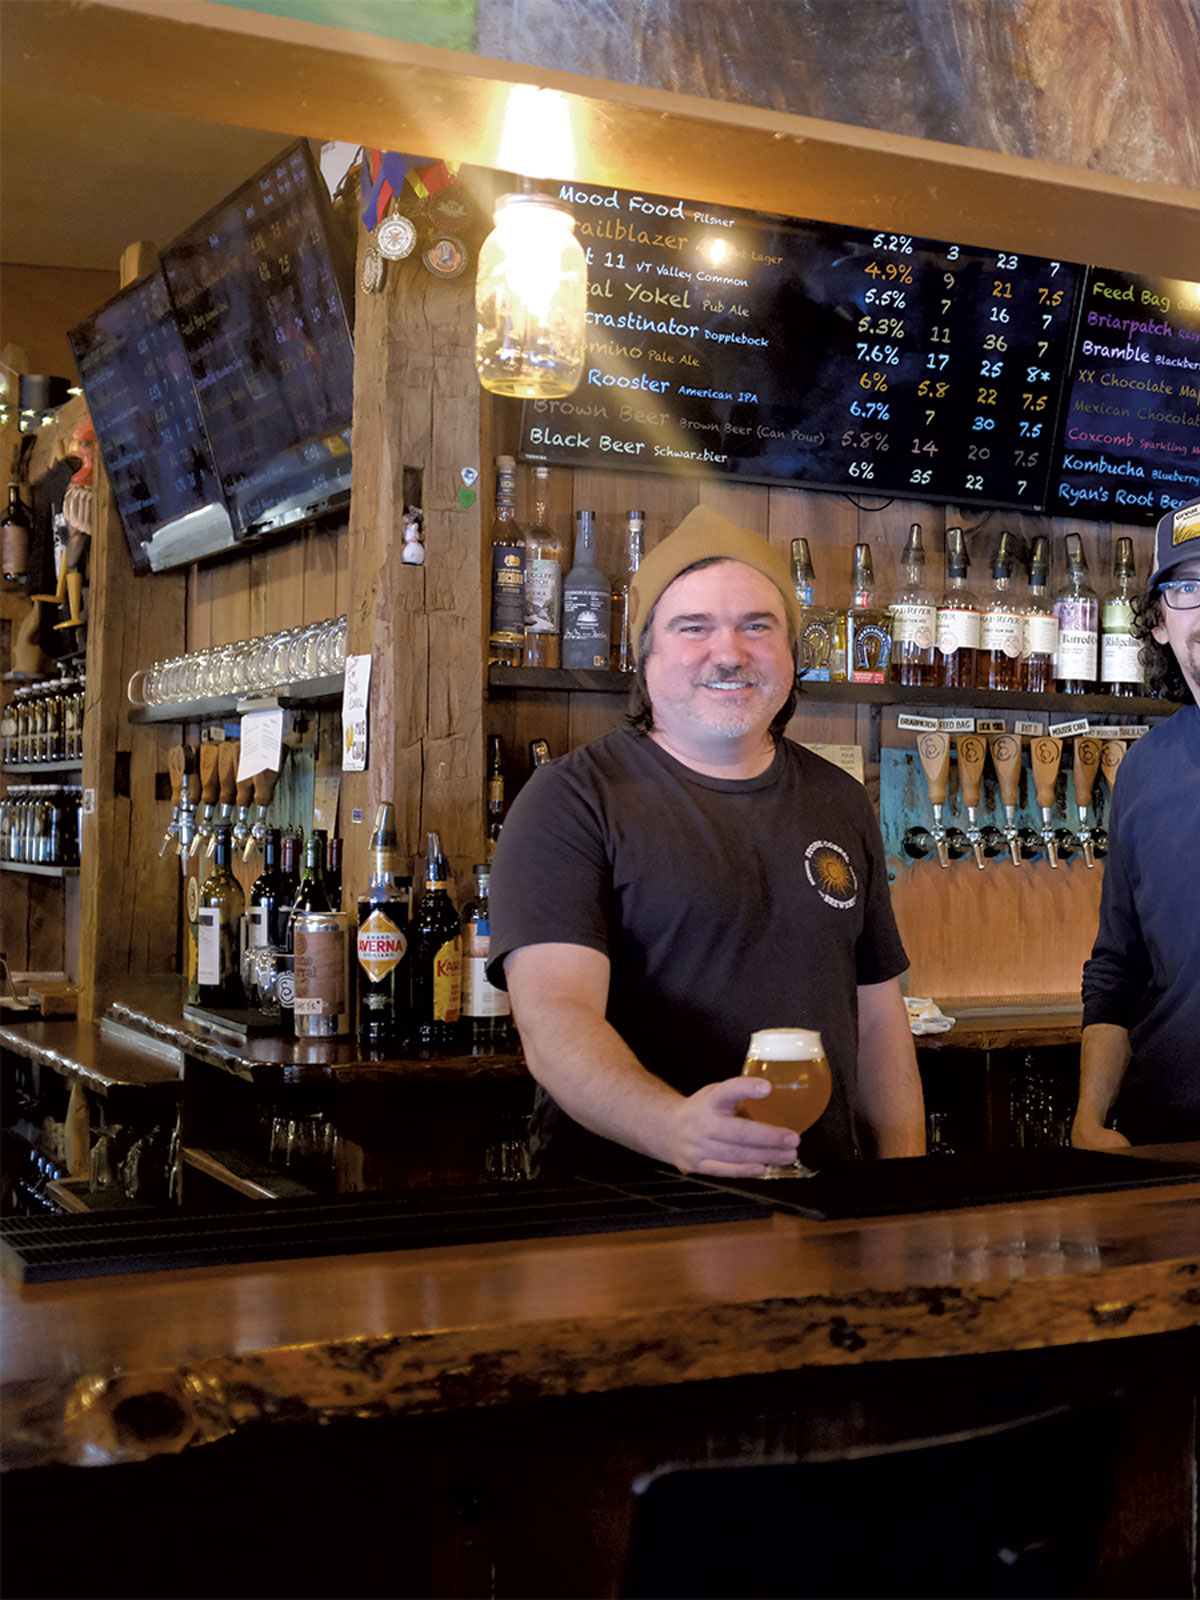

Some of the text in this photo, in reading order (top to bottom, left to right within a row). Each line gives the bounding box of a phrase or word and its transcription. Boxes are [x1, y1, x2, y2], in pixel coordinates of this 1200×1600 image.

[559, 185, 1060, 277] Mood Food Pilsner 5.2% 3 23 7
[604, 252, 626, 269] 11
[636, 262, 652, 273] VT
[656, 265, 692, 282] Valley
[696, 271, 749, 288] Common
[865, 288, 906, 309] 5.5%
[941, 300, 951, 315] 7
[990, 307, 1010, 323] 16
[1042, 315, 1052, 330] 7
[751, 250, 783, 266] Lager
[864, 262, 913, 284] 4.9%
[944, 273, 955, 289] 9
[992, 281, 1013, 298] 21
[1038, 288, 1064, 307] 7.5
[1093, 282, 1134, 302] Feed
[1140, 289, 1171, 313] Bag
[624, 282, 692, 309] Yokel
[702, 299, 725, 313] Pub
[728, 301, 750, 317] Ale
[858, 316, 905, 338] 5.3%
[930, 327, 951, 343] 11
[983, 334, 1008, 352] 36
[1038, 342, 1049, 357] 7
[1087, 312, 1172, 340] Briarpatch
[584, 311, 700, 339] crastinator
[703, 329, 769, 347] Dopplebock
[856, 343, 900, 365] 7.6%
[926, 353, 950, 371] 17
[980, 360, 1004, 378] 25
[1082, 340, 1150, 364] Bramble
[588, 368, 1043, 438] Rooster American IPA 6.7% 7 30 7.5
[648, 350, 674, 365] Pale
[679, 352, 700, 368] Ale
[859, 372, 888, 392] 6%
[918, 380, 950, 399] 5.8
[977, 388, 998, 405] 22
[1022, 393, 1048, 411] 7.5
[1077, 369, 1095, 384] XX
[1101, 373, 1173, 395] Chocolate
[1072, 400, 1130, 417] Mexican
[534, 398, 1039, 467] Brown Beer Brown Beer (Can Pour) 5.8% 14 20 7.5
[1068, 427, 1135, 447] Coxcomb
[1140, 437, 1187, 456] Sparkling
[530, 428, 1027, 495] Black Beer Schwarzbier 6% 35 22 7
[1062, 454, 1145, 478] Kombucha
[1151, 469, 1200, 487] Blueberry
[1058, 483, 1109, 507] Ryan's
[1115, 488, 1155, 508] Root
[1160, 495, 1187, 509] Bee
[359, 940, 403, 953] AVERNA
